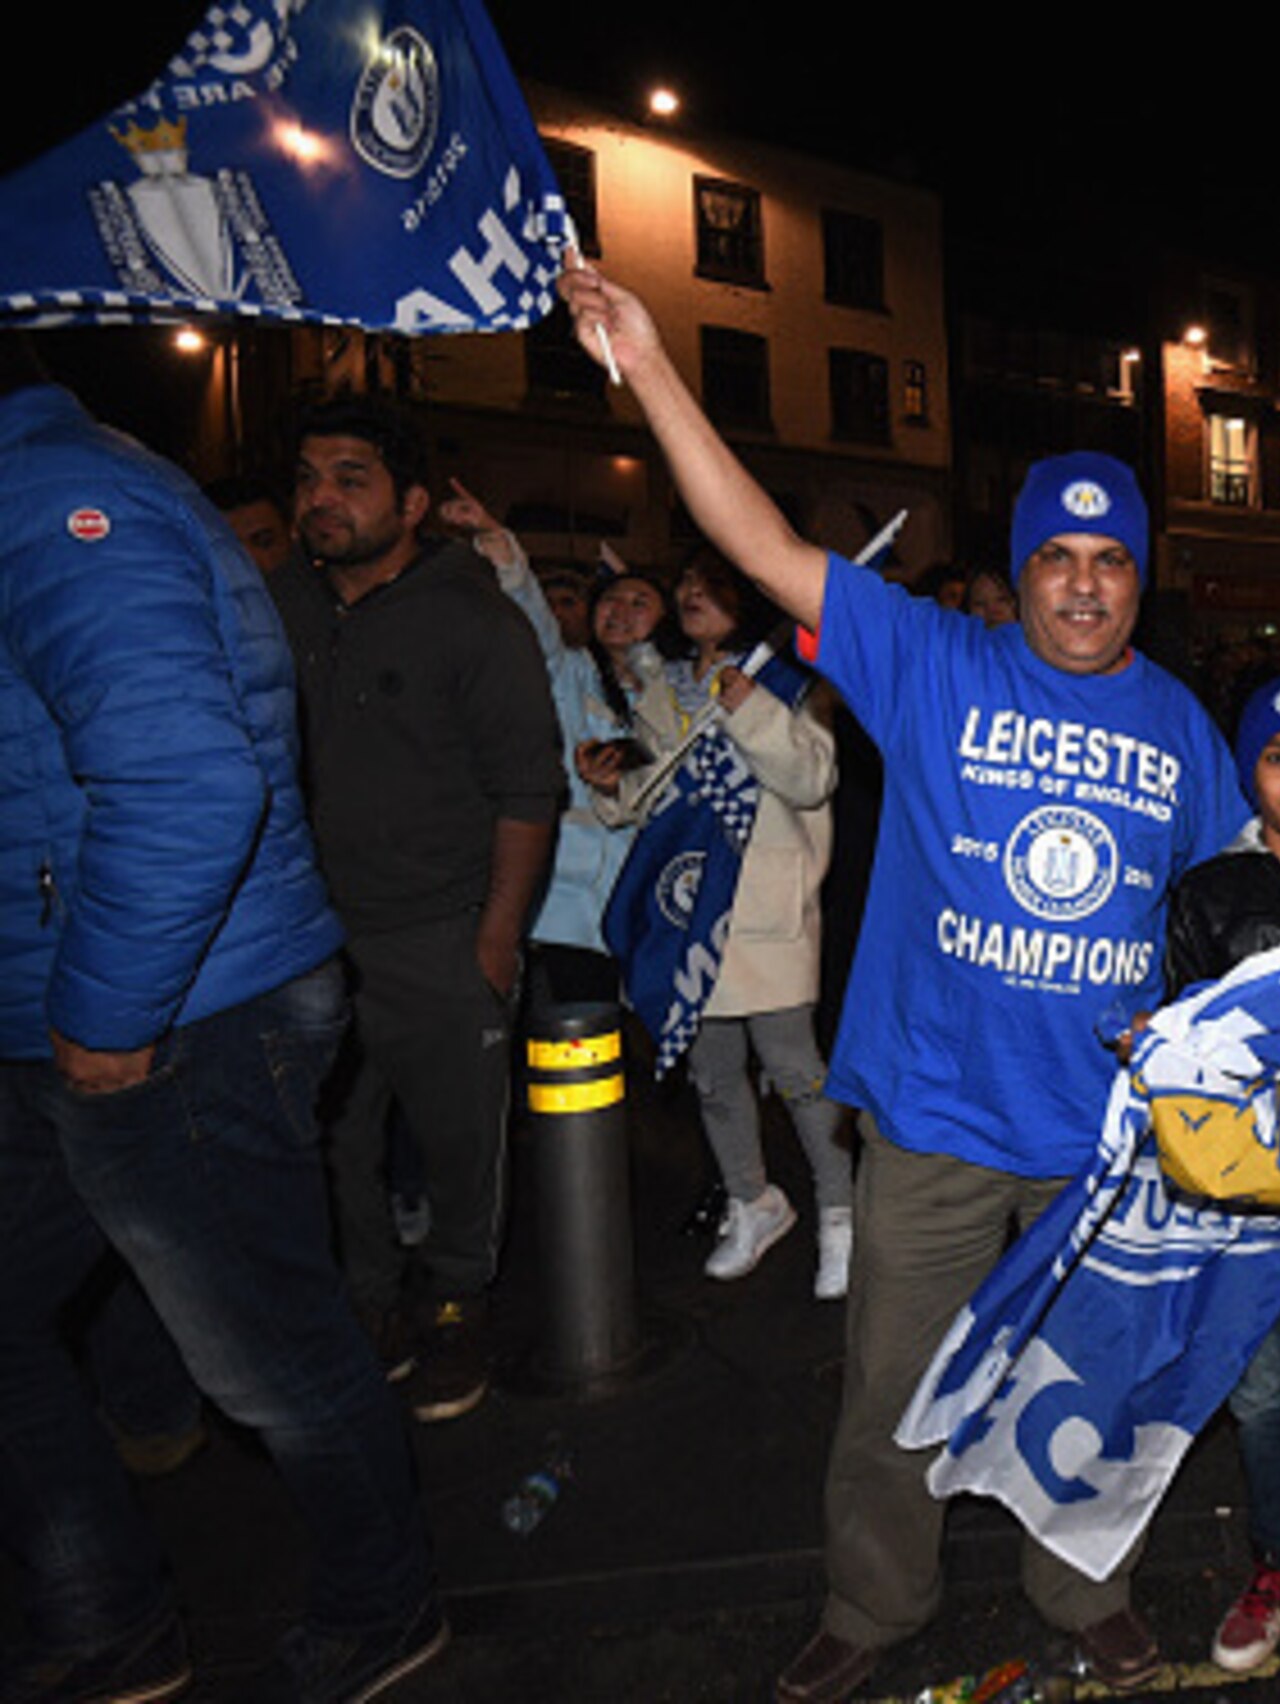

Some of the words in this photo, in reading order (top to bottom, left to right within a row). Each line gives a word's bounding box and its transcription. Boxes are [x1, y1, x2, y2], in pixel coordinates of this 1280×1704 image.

[959, 705, 1181, 803] LEICESTER
[960, 763, 1034, 790] KINGS
[1038, 775, 1069, 797] OF
[1074, 782, 1172, 823] ENGLAND
[936, 908, 1155, 986] CHAMPIONS
